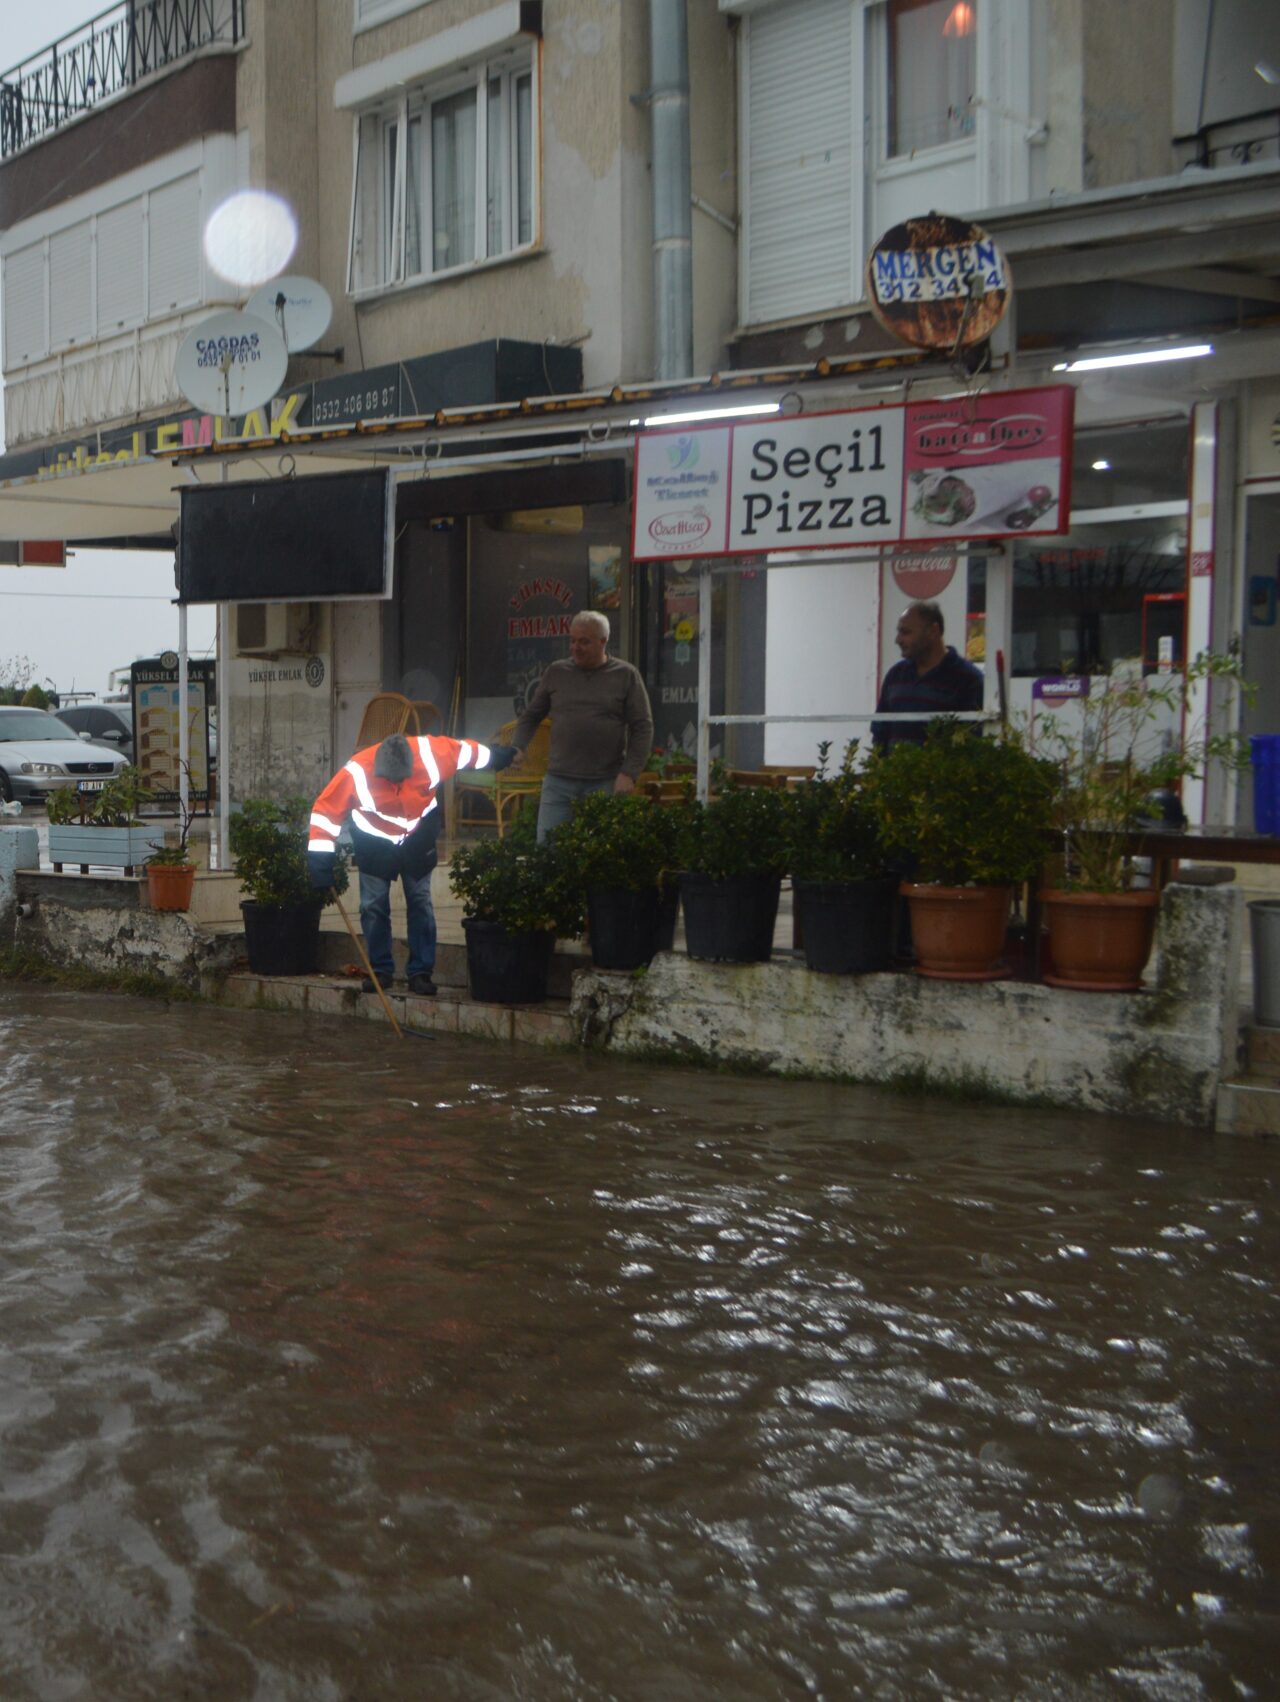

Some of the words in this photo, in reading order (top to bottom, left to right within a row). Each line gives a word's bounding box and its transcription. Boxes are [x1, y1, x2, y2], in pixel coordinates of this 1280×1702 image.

[875, 239, 996, 281] MERGEN
[880, 281, 922, 300] 312
[315, 399, 341, 421] 0532
[365, 390, 378, 410] 89
[382, 386, 395, 407] 87
[750, 424, 886, 488] Seçil
[740, 490, 892, 536] Pizza
[508, 614, 572, 639] EMLAK
[174, 671, 205, 681] ELAK
[248, 669, 277, 683] YÜKSEL
[278, 668, 303, 681] EMLAK
